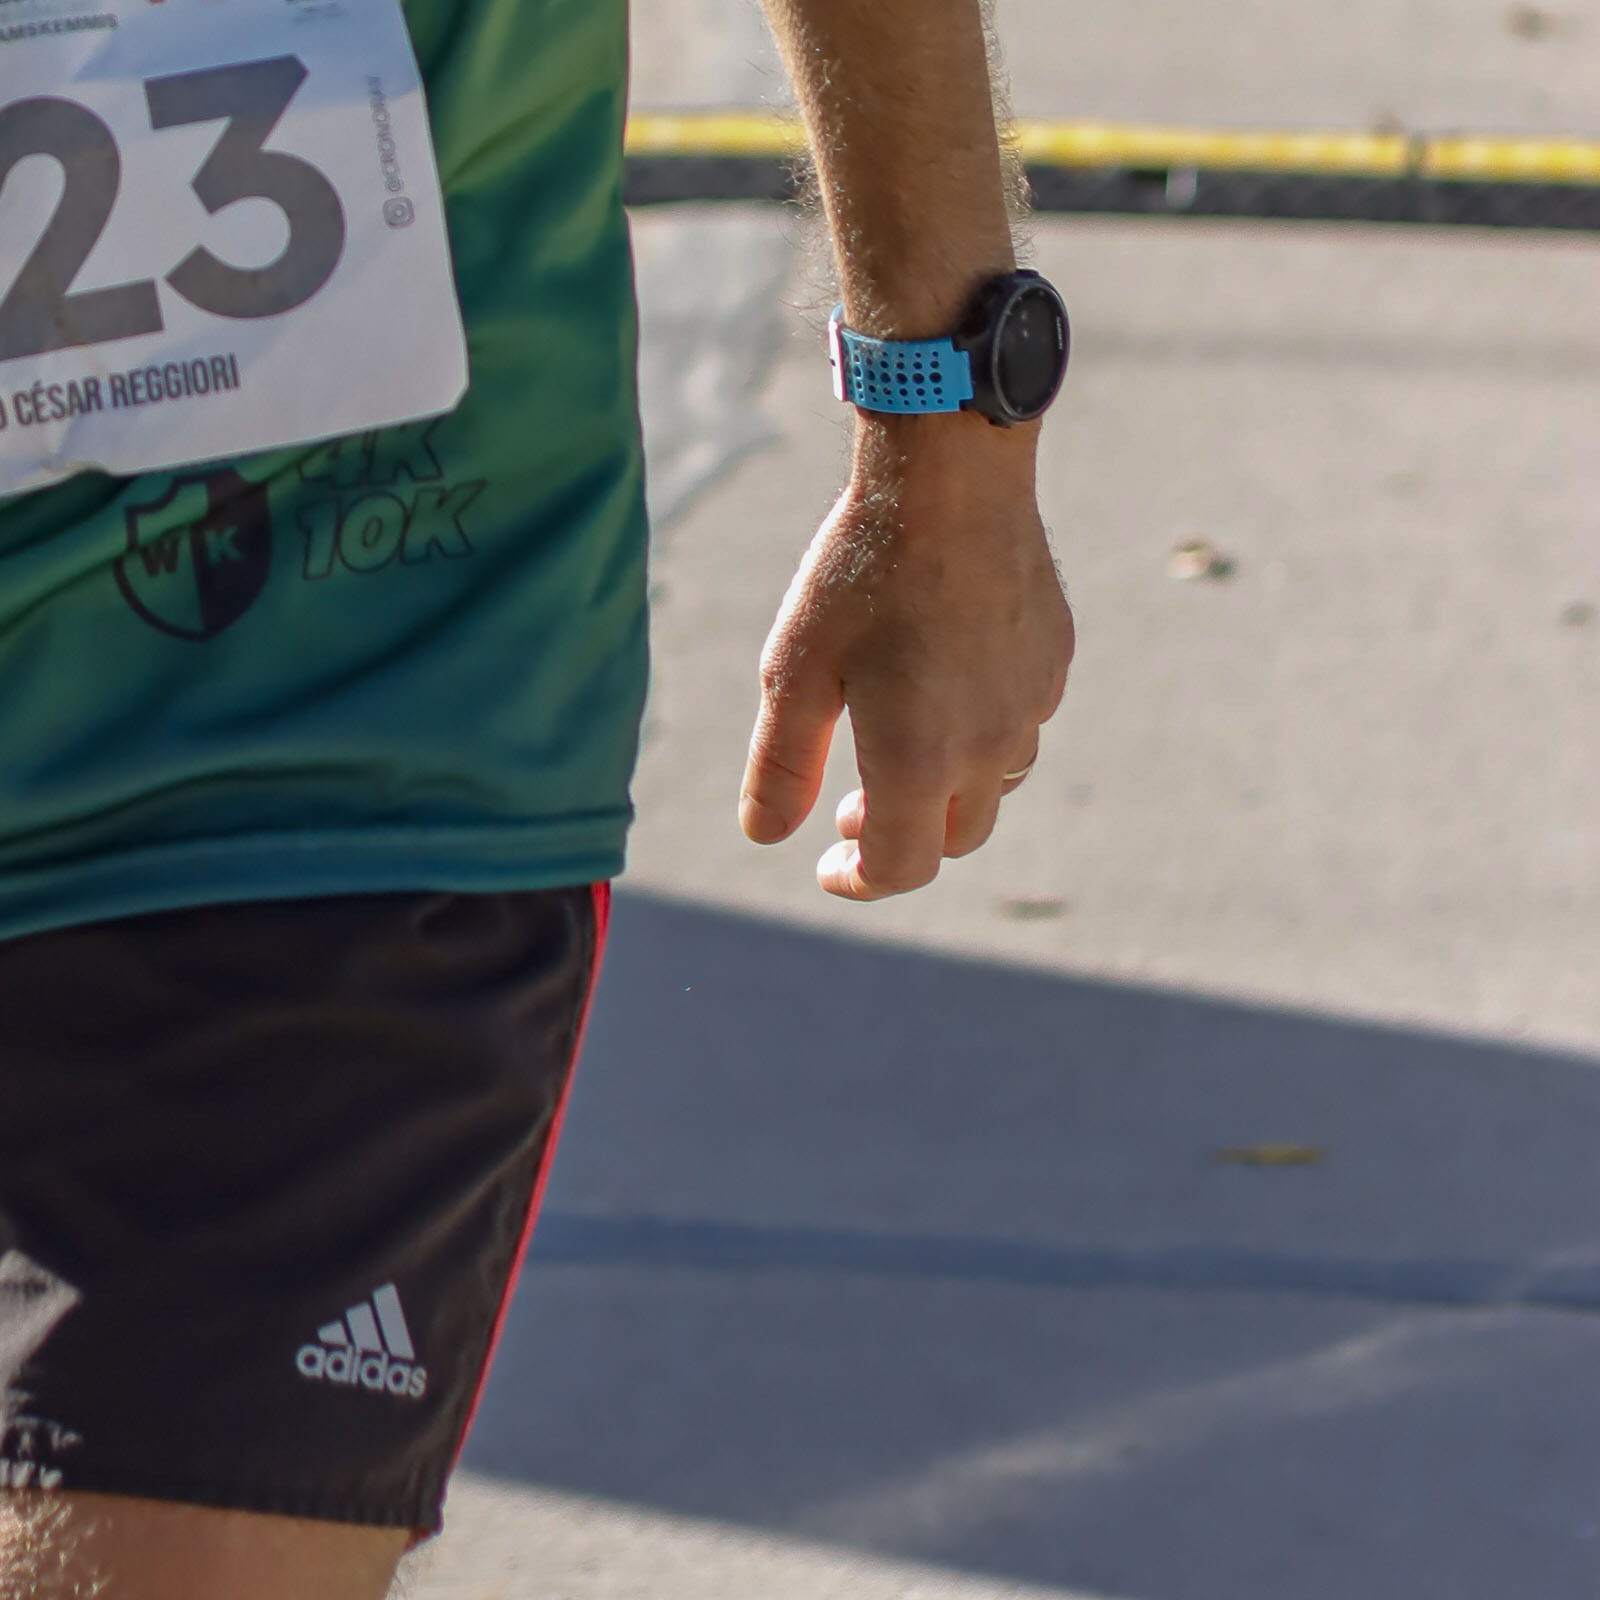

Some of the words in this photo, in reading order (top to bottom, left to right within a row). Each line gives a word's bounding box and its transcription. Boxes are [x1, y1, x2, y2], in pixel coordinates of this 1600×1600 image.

[11, 378, 105, 427] CÉSAR
[107, 352, 241, 409] REGGIORI
[296, 477, 487, 582] 10K
[295, 1343, 428, 1398] adidas
